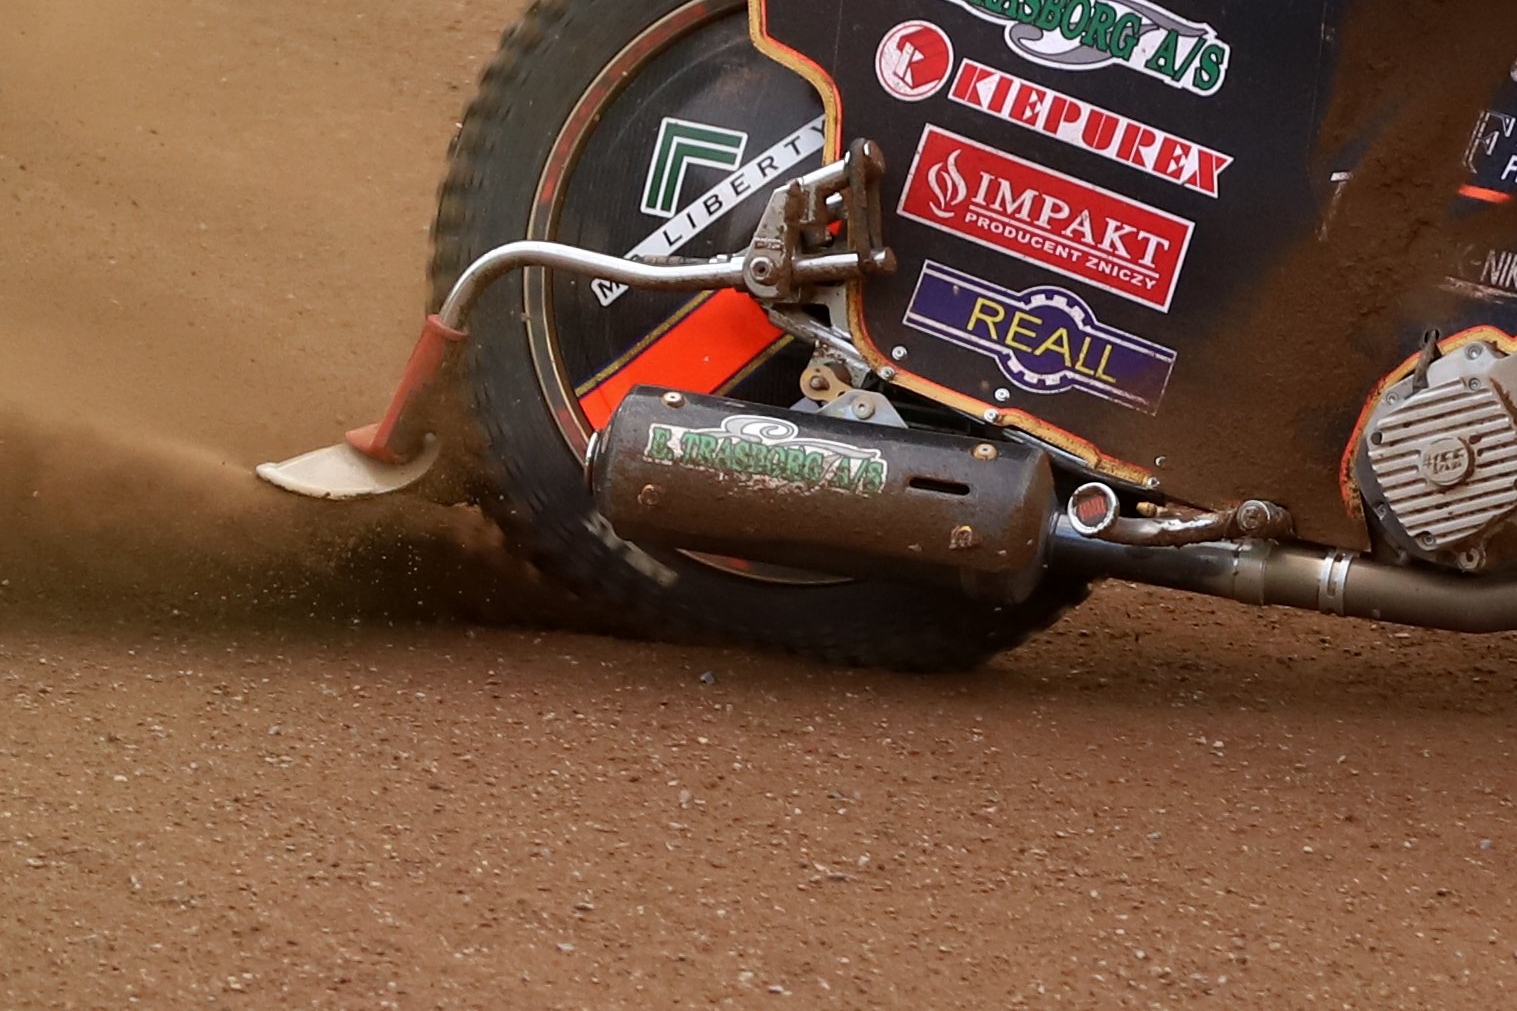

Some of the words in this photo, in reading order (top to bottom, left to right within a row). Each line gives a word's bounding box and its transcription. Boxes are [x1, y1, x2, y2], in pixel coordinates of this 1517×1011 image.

[1144, 24, 1226, 92] A/S
[952, 61, 1232, 195] KIEPUREX
[663, 119, 826, 248] LIBERTY
[970, 170, 1171, 270] IMPAKT
[965, 212, 1081, 263] PRODUCENT
[1085, 254, 1158, 291] ZNICZY
[967, 296, 1118, 384] REALL
[680, 431, 824, 483] TRASBORG
